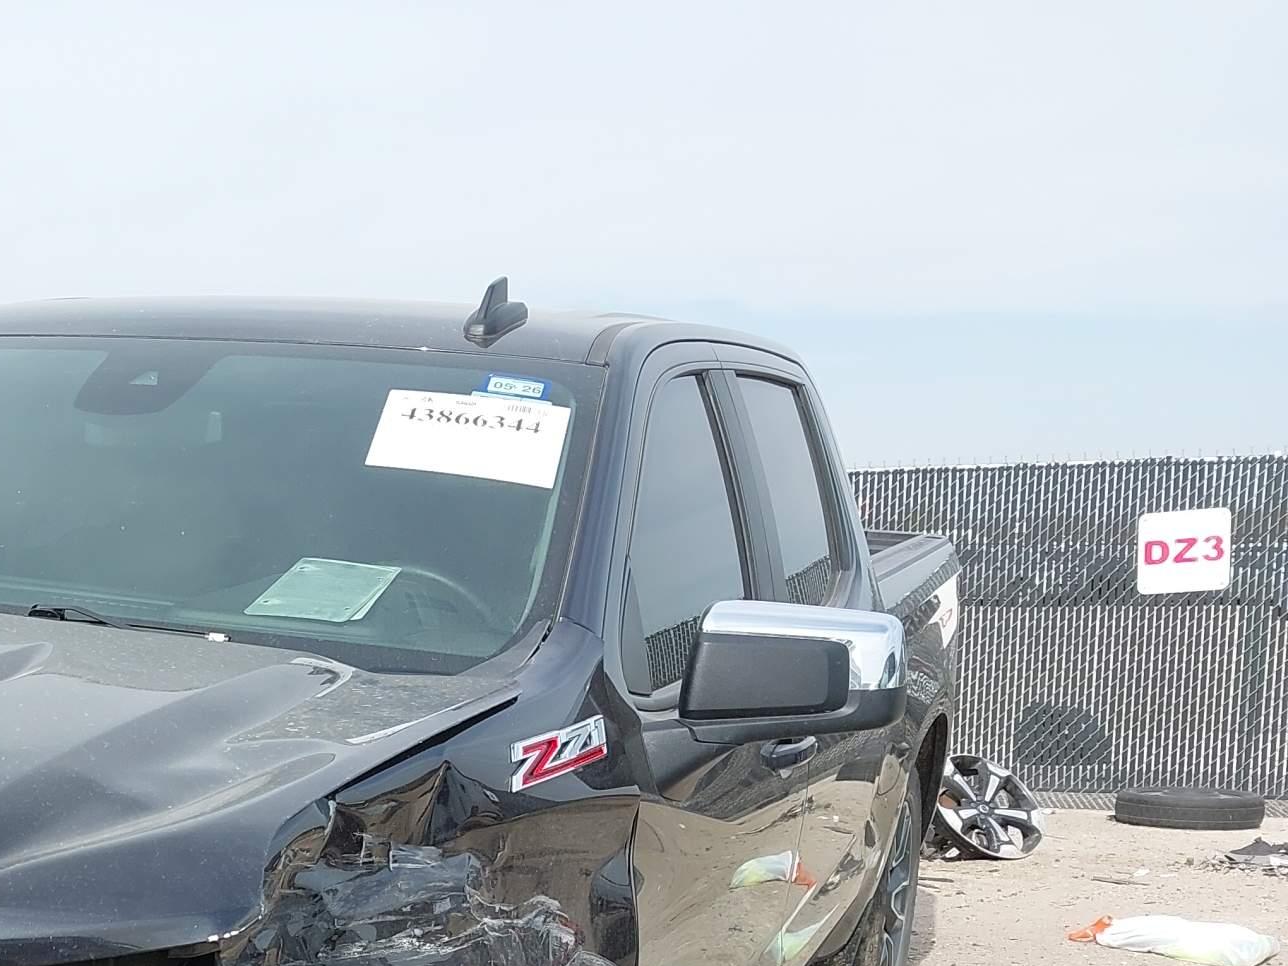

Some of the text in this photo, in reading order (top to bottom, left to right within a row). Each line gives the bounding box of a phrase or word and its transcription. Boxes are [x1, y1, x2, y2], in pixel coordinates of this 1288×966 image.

[401, 407, 541, 433] 43866344
[1143, 535, 1225, 565] DZ3
[510, 714, 607, 793] Z71
